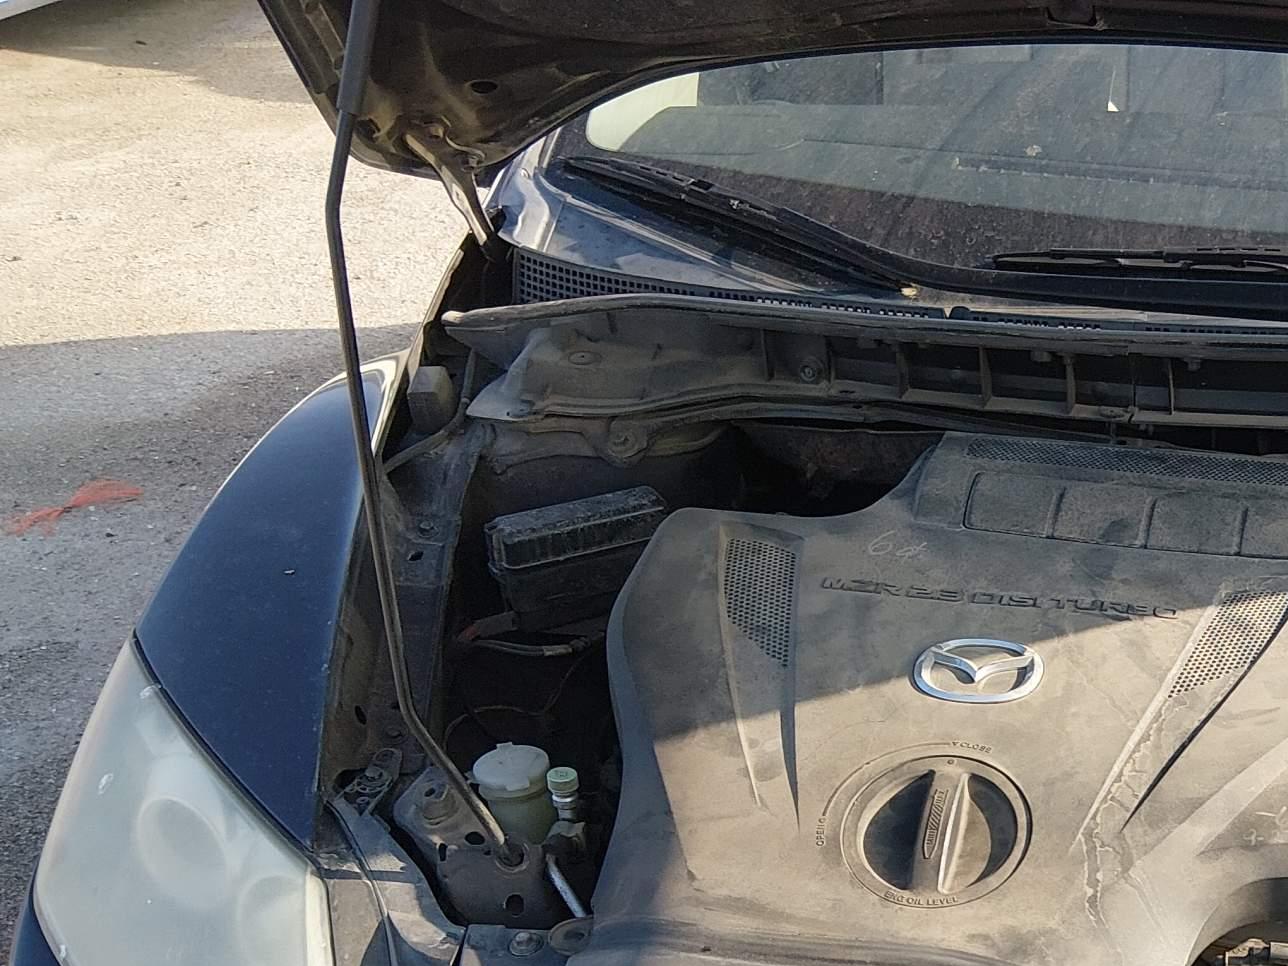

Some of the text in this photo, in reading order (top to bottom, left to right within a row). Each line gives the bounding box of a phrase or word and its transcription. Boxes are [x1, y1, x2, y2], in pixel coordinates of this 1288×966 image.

[822, 577, 902, 597] MZR
[969, 591, 1041, 609] DISI
[1050, 598, 1179, 620] TURBO
[906, 896, 924, 906] OIL
[926, 895, 959, 906] LEVEL
